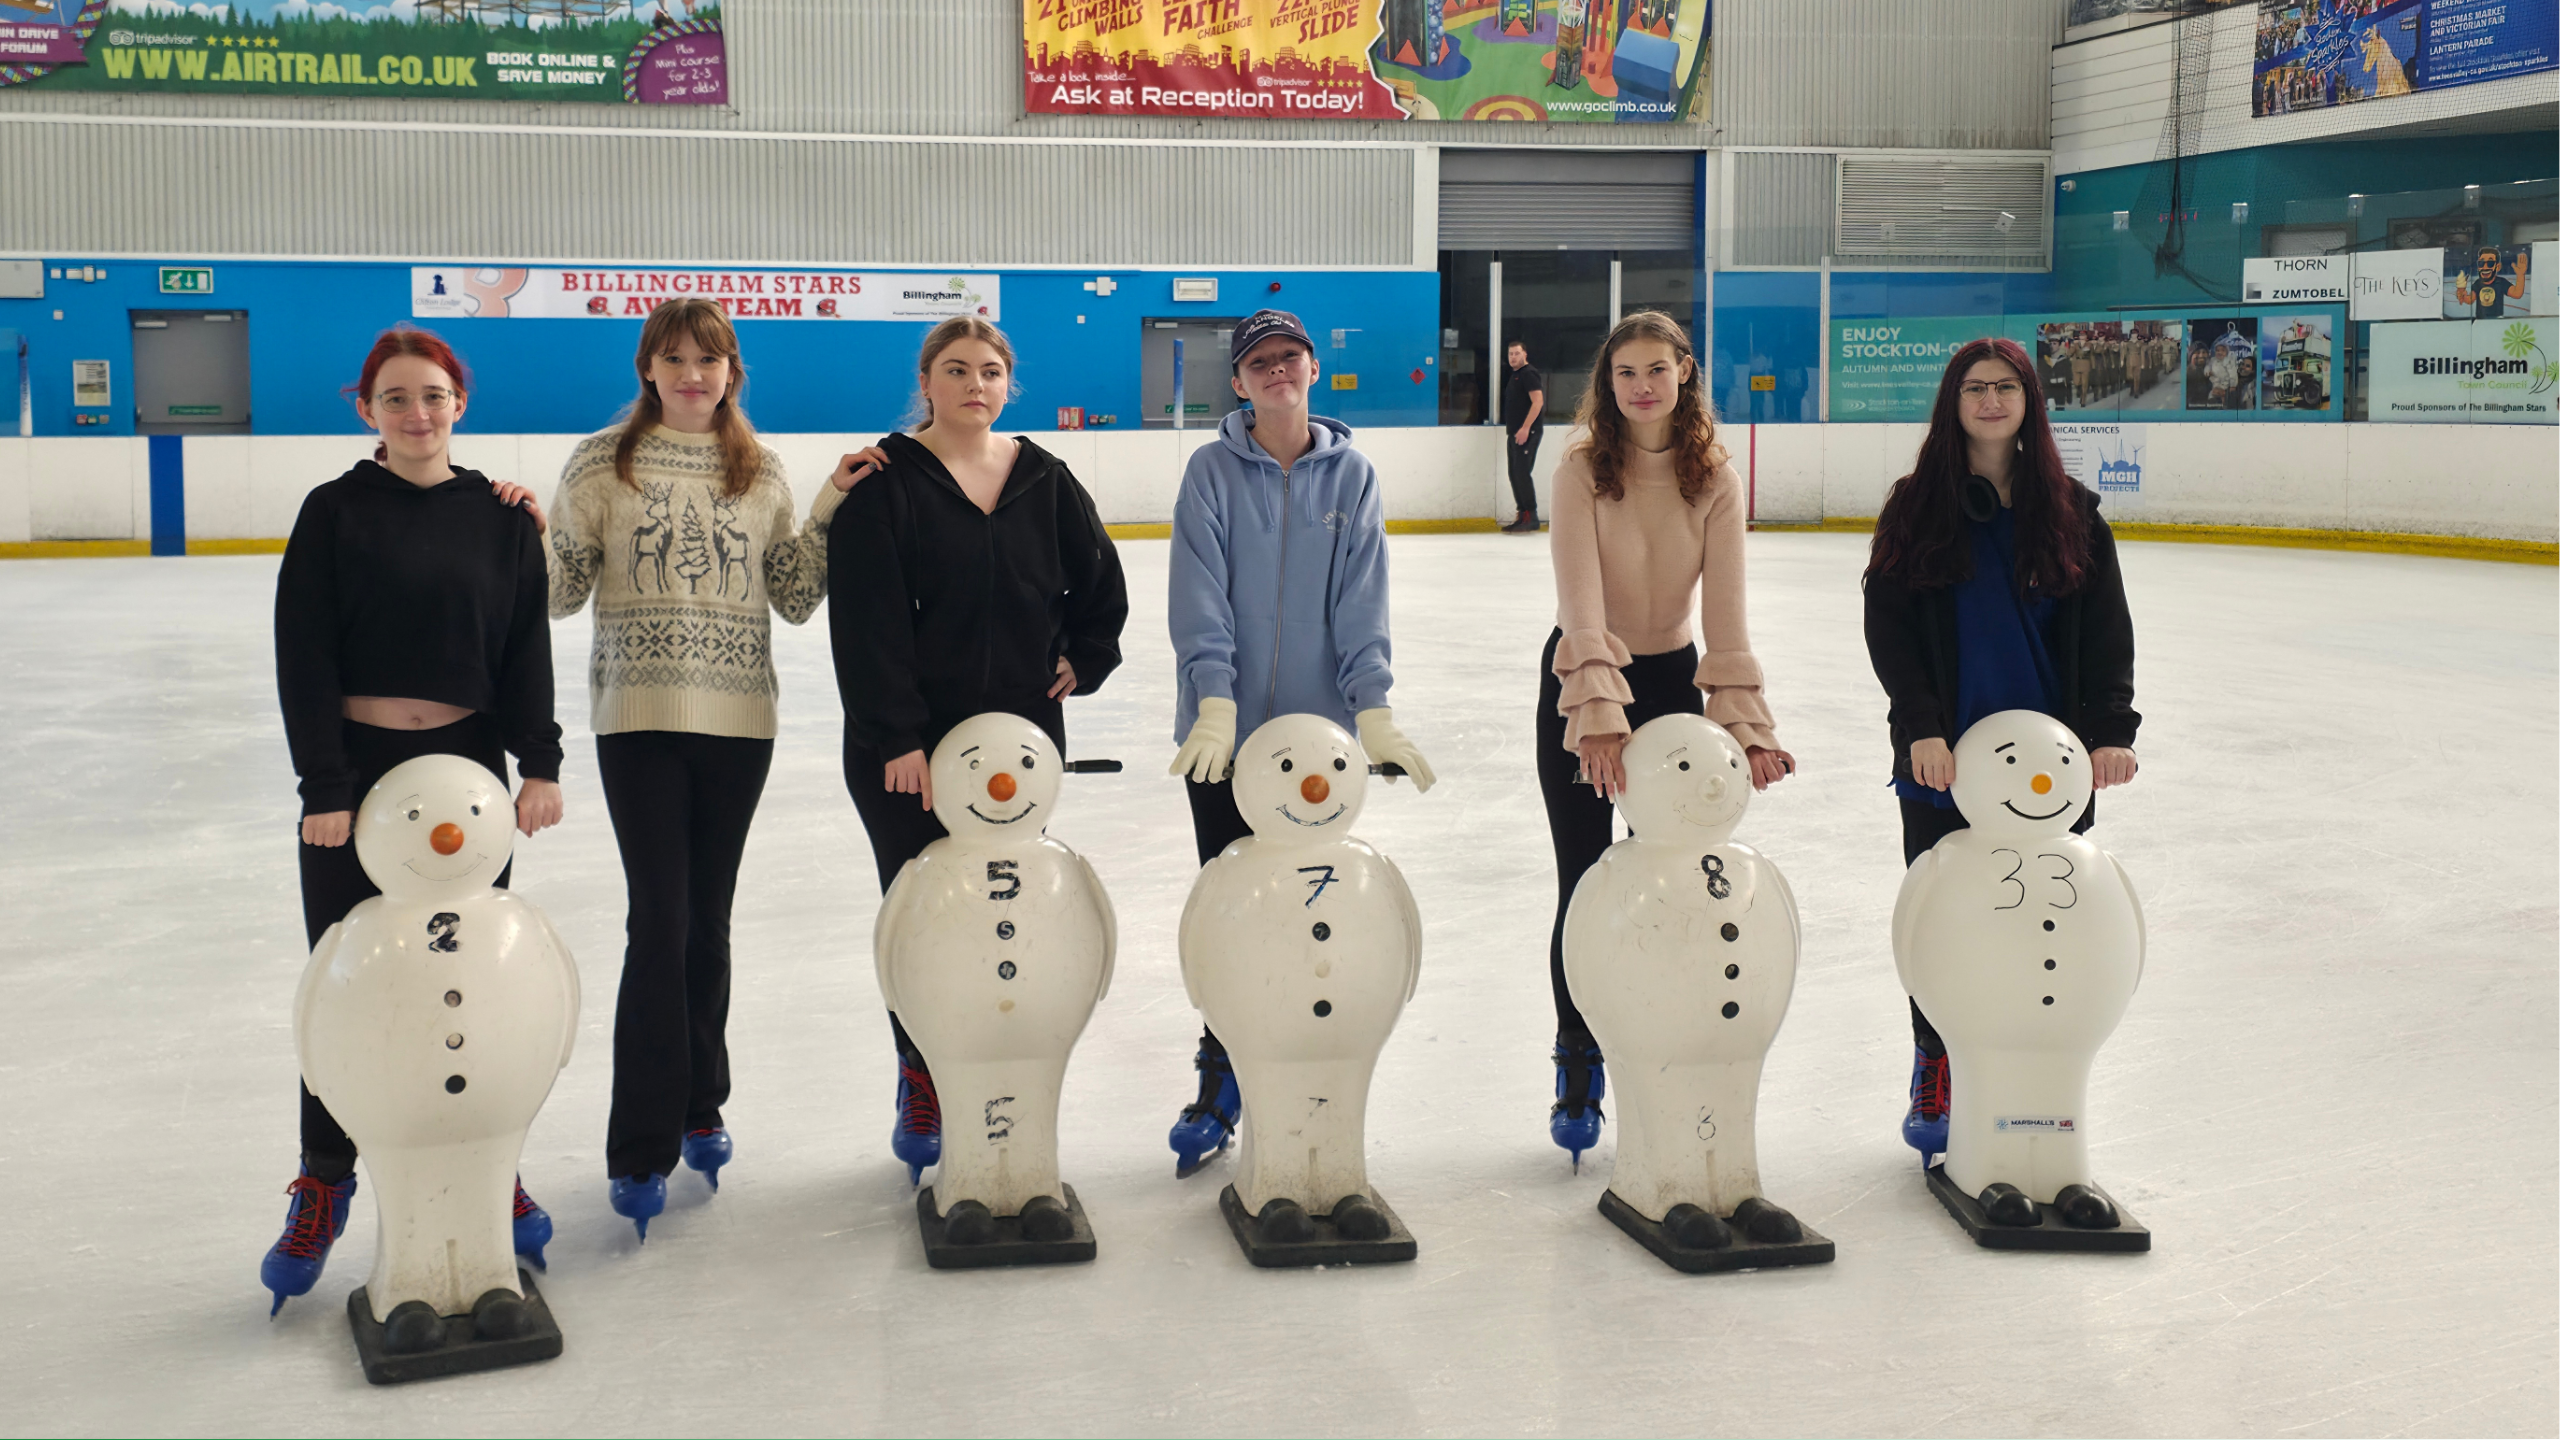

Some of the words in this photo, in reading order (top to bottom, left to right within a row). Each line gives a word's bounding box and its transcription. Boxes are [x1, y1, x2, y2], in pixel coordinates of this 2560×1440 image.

[1094, 5, 1143, 37] WALLS
[1163, 0, 1240, 37] FAITH
[1270, 6, 1318, 28] VERTICAL
[1298, 4, 1359, 44] SLIDE
[2430, 12, 2474, 28] CHRISTMAS
[2475, 6, 2507, 20] MARKET
[18, 28, 59, 39] DRIVE
[1197, 15, 1254, 40] CHALLENGE
[2430, 27, 2445, 37] AND
[2446, 19, 2487, 34] VICTORIAN
[2488, 15, 2506, 26] FAIR
[136, 33, 194, 46] tripadvisor
[2429, 41, 2463, 56] LANTERN
[2464, 36, 2494, 50] PARADE
[1, 42, 48, 54] FORUM
[675, 44, 695, 55] Plus
[102, 48, 478, 87] WWW.AIRTRAIL.CO.UK
[486, 52, 534, 66] BOOK
[538, 53, 598, 67] ONLINE
[603, 55, 616, 68] &
[681, 55, 720, 68] course
[497, 70, 543, 83] SAVE
[548, 71, 606, 85] MONEY
[668, 69, 686, 83] for
[692, 68, 712, 80] 2-3
[1028, 71, 1056, 83] Take
[1060, 73, 1067, 82] a
[1069, 71, 1090, 82] look
[1273, 78, 1310, 88] tripadvisor
[663, 85, 688, 100] year
[692, 80, 720, 95] olds!
[1050, 85, 1102, 105] Ask
[1110, 87, 1134, 105] at
[1141, 86, 1274, 110] Reception
[1281, 89, 1364, 113] Today!
[1546, 100, 1677, 113] www.goclimb.co.uk
[2273, 258, 2328, 272] THORN
[561, 272, 764, 293] BILLINGHAM
[774, 275, 861, 295] STARS
[902, 290, 962, 302] Billingham
[2272, 288, 2345, 300] ZUMTOBEL
[715, 297, 802, 317] TEAM
[1842, 327, 1901, 342] ENJOY
[1842, 364, 1888, 374] AUTUMN
[1890, 363, 1915, 373] AND
[2412, 356, 2529, 379] Billingham
[2457, 380, 2486, 389] Town
[2487, 380, 2528, 389] Council
[2391, 402, 2416, 411] Proud
[2417, 403, 2456, 413] Sponsors
[2458, 402, 2467, 411] of
[2469, 403, 2482, 411] The
[2484, 403, 2524, 413] Billingham
[2526, 403, 2547, 412] Stars
[2080, 426, 2120, 434] SERVICES
[2101, 471, 2138, 483] MGH
[986, 859, 1022, 902] 5
[1700, 854, 1732, 899] 8
[1991, 848, 2078, 910] 33
[1296, 865, 1339, 908] 7
[427, 912, 462, 953] 2
